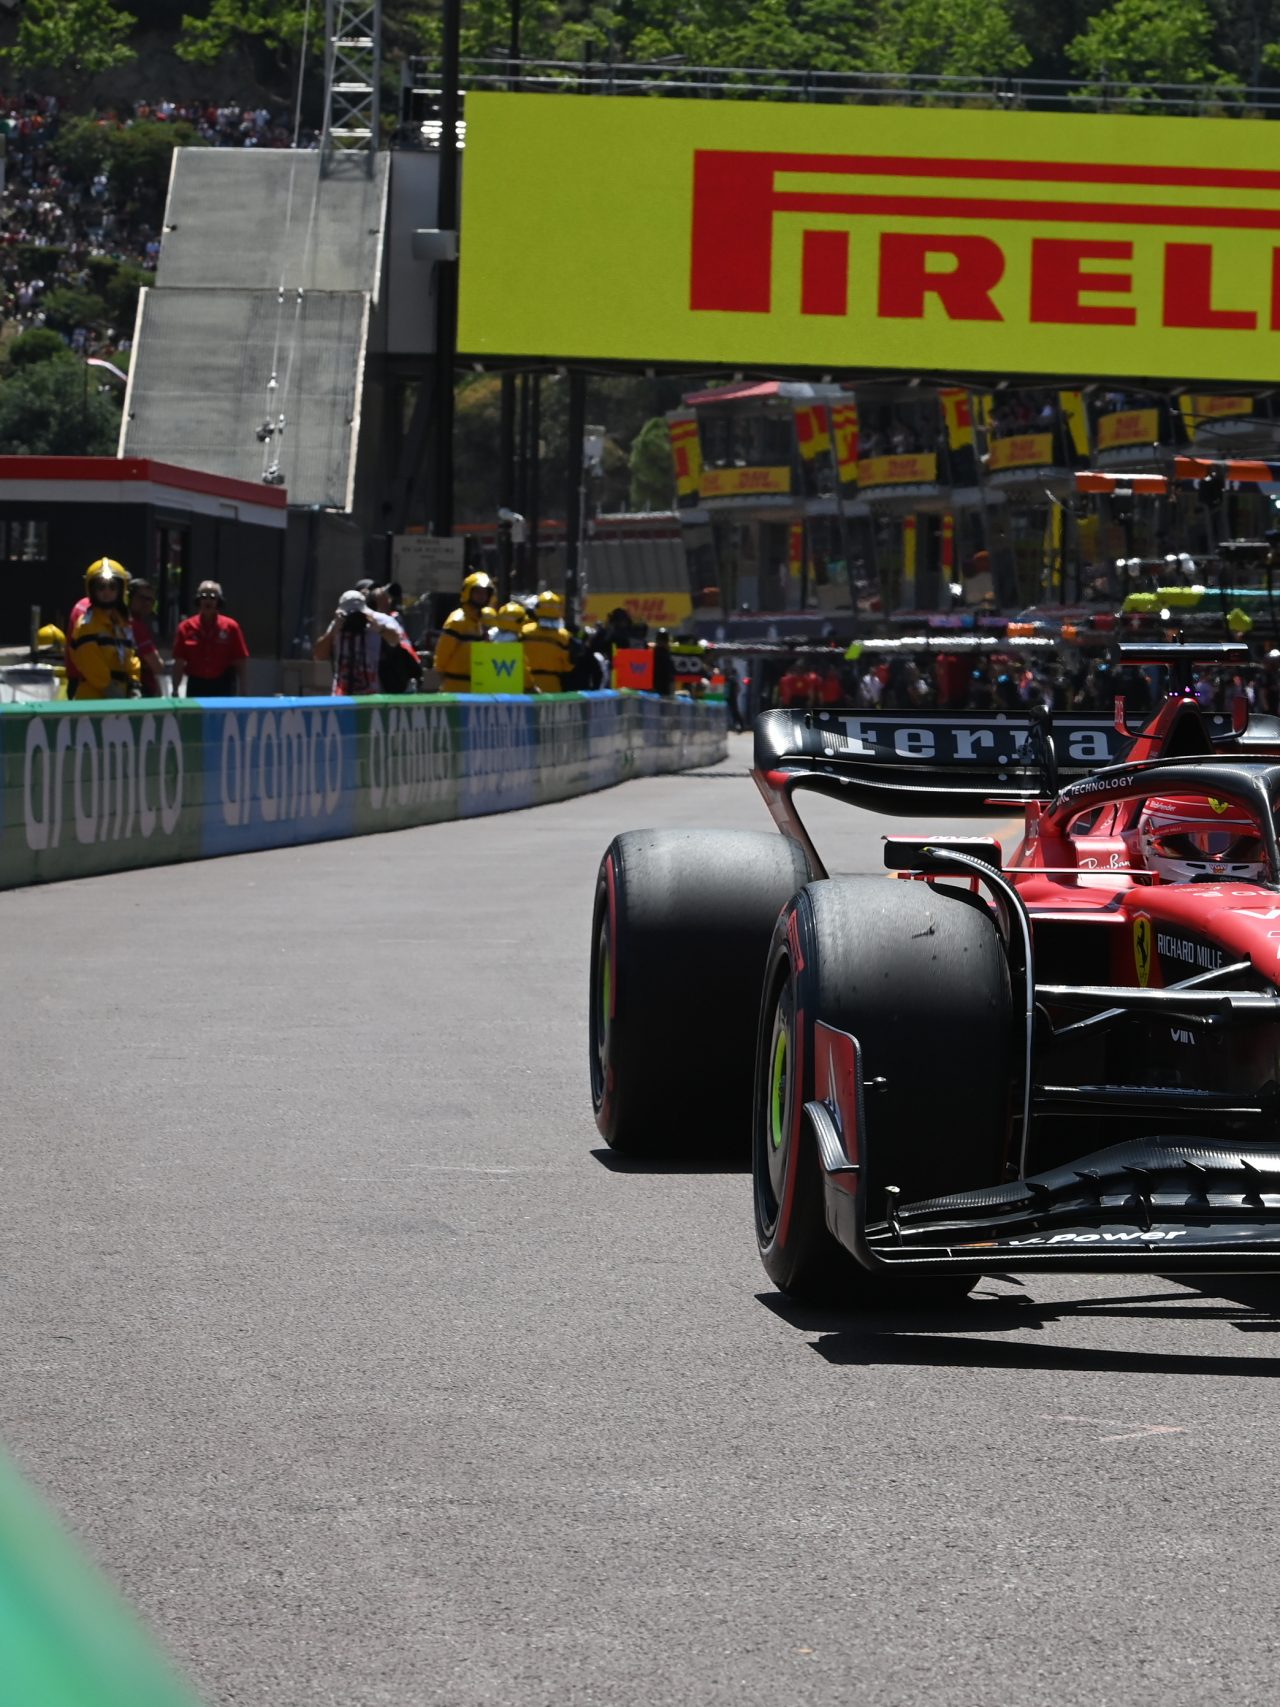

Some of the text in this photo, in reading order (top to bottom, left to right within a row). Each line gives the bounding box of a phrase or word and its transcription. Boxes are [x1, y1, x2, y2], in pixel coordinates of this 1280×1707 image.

[491, 659, 516, 677] W
[24, 711, 184, 851] aramco
[221, 708, 343, 827] aramco
[369, 707, 452, 811] aramco
[1070, 776, 1135, 797] TECHNOLOGY
[1157, 933, 1223, 970] RICHARD MILLE
